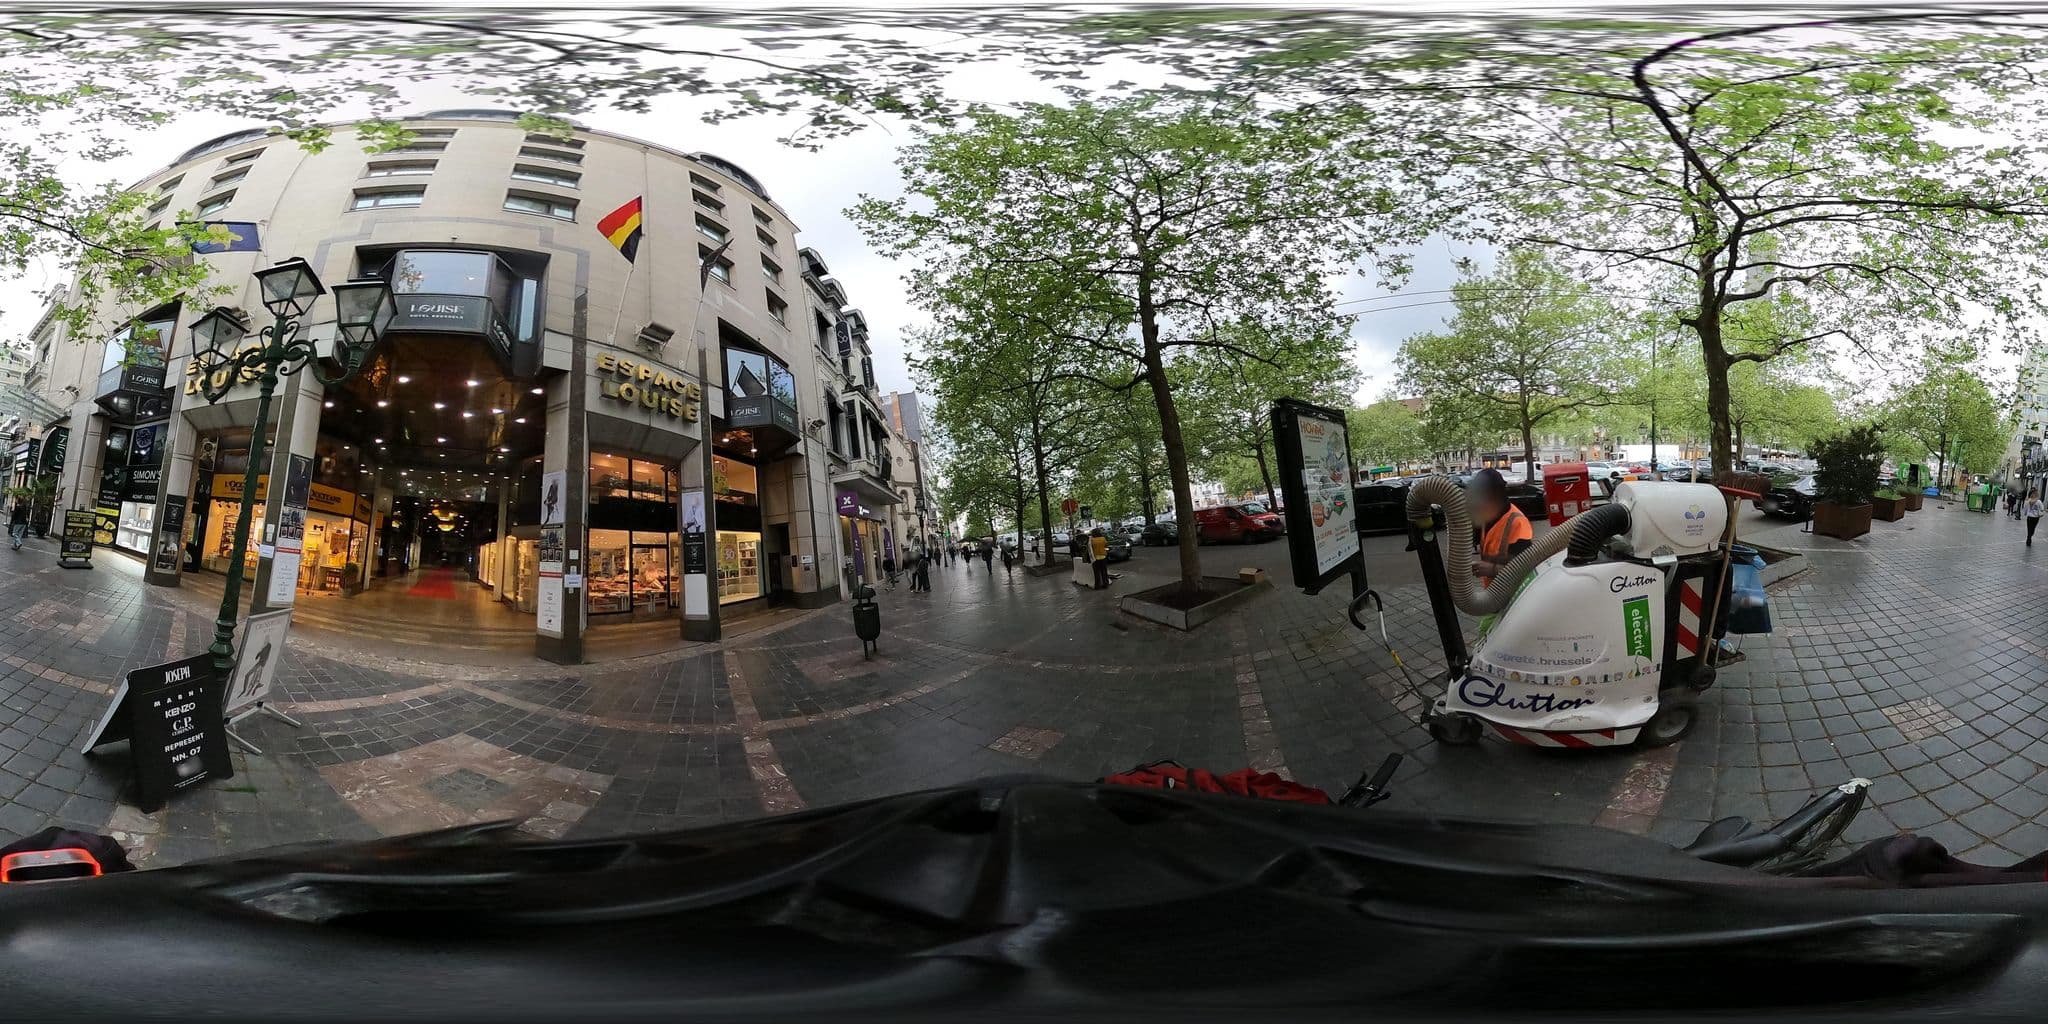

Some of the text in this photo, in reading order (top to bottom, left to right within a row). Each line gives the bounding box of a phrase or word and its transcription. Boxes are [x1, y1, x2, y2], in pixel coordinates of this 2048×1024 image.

[410, 304, 465, 313] LOUISE
[131, 374, 159, 384] LOUISE
[597, 352, 701, 402] ESPACE
[601, 380, 699, 423] LOUISE
[730, 407, 761, 417] LOUISE
[132, 470, 162, 480] SIMON'S
[1610, 576, 1657, 593] Glutton
[1631, 608, 1645, 655] electric
[165, 666, 191, 684] JOSEPH
[1458, 675, 1595, 712] Glutton
[165, 702, 196, 719] KENZO
[164, 732, 205, 753] REPRESENT
